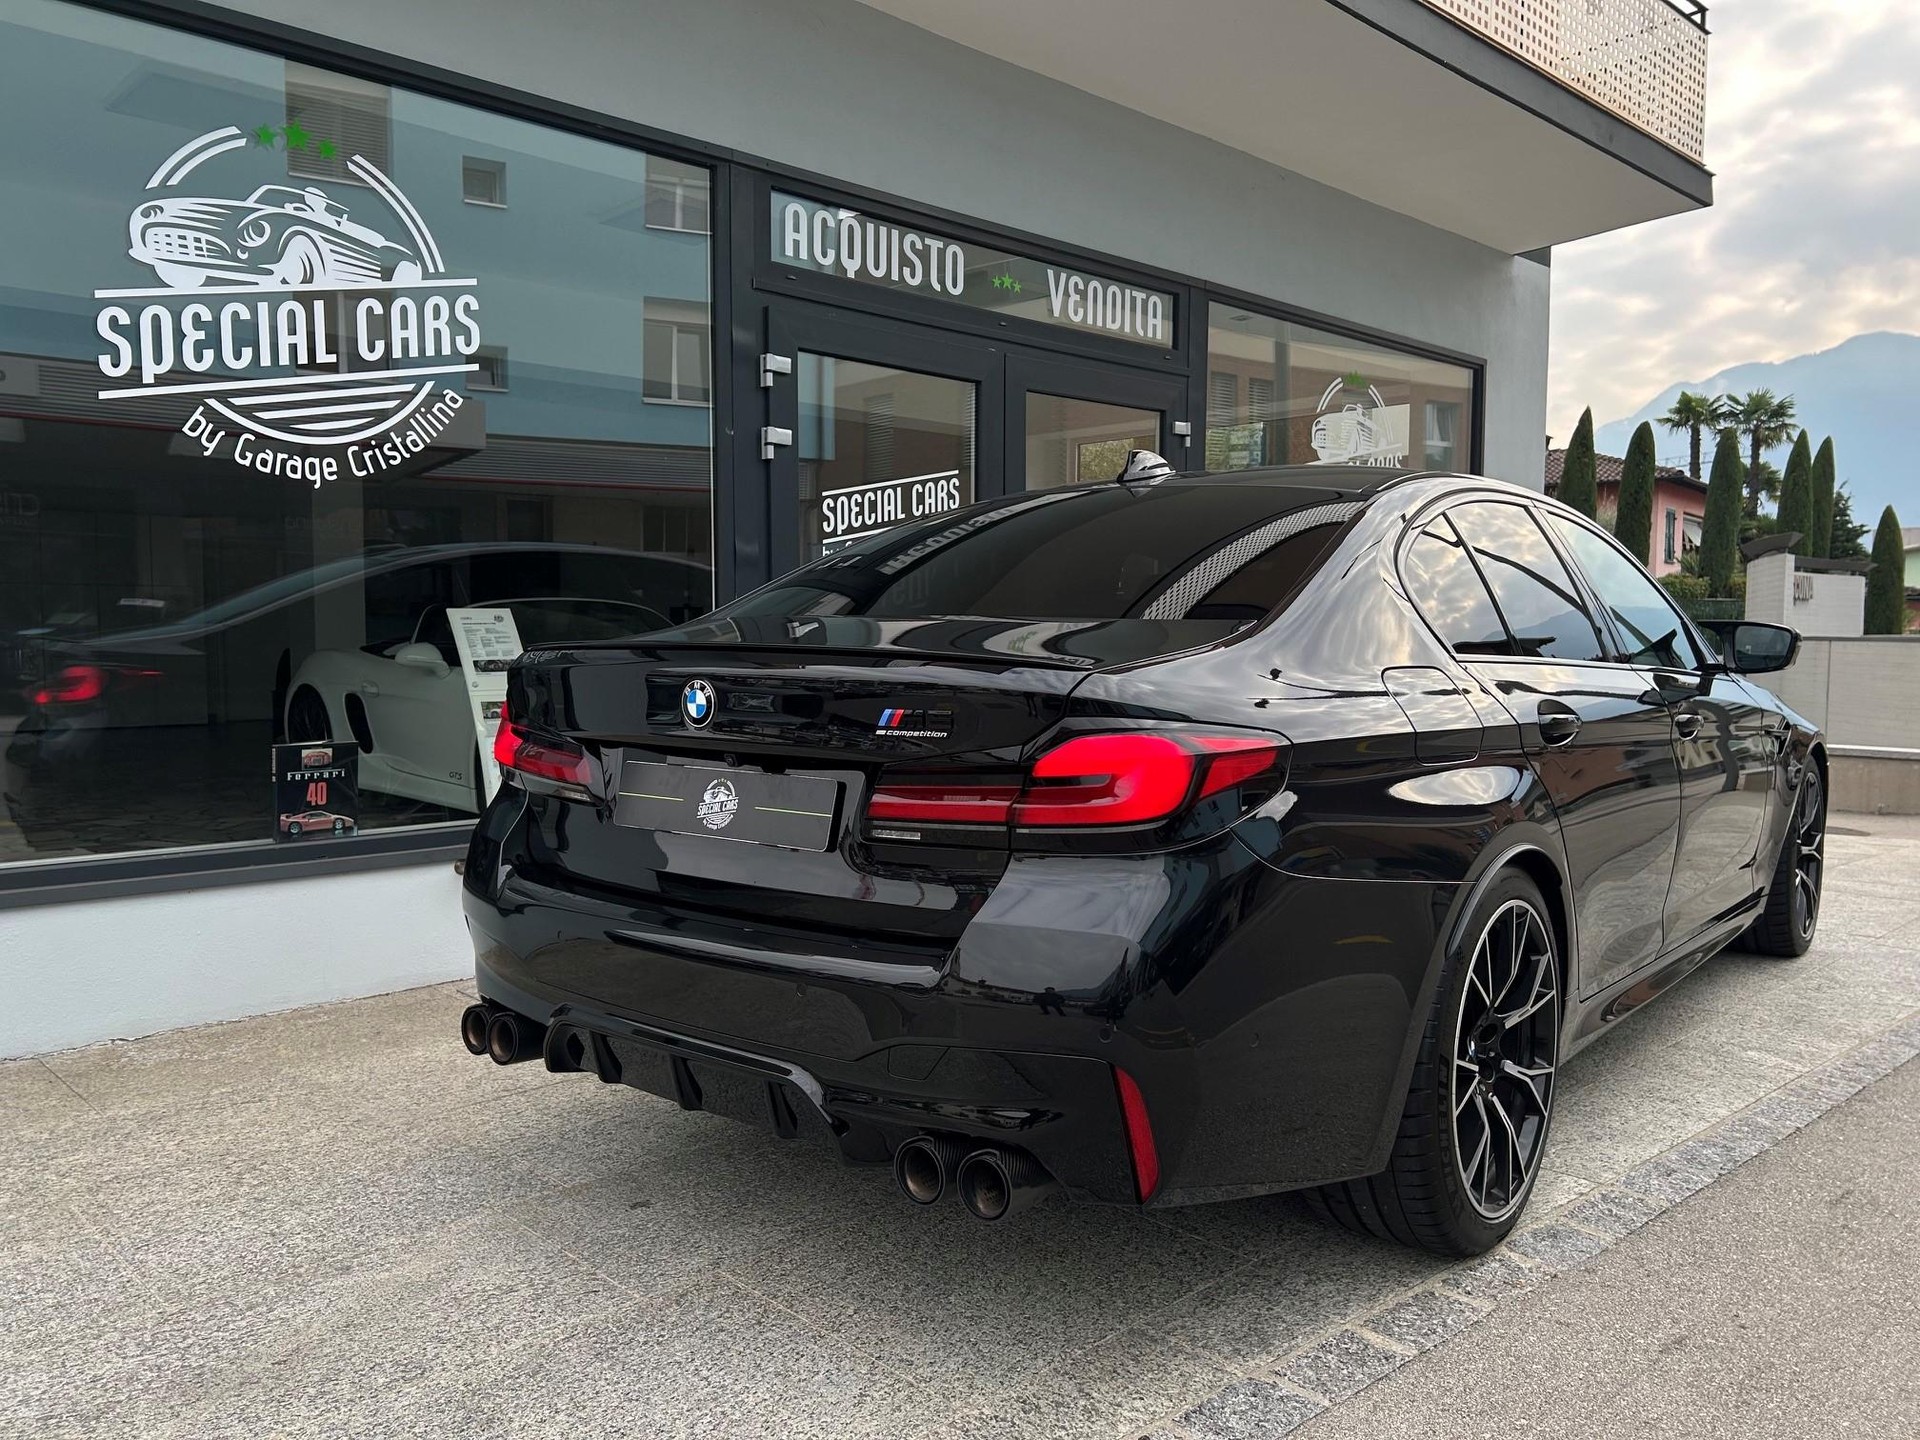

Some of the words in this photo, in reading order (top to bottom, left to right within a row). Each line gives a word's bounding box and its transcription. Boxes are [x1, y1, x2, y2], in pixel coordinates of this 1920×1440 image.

[784, 202, 965, 296] ACQUISTO
[1047, 268, 1163, 340] VENDITA
[96, 300, 337, 384] SPECIAL
[357, 294, 481, 362] CARS
[182, 405, 226, 458] by
[233, 433, 339, 489] Garage
[347, 388, 464, 478] Cristallina
[822, 486, 906, 535] SPECIAL
[911, 478, 960, 517] CARS
[886, 729, 948, 739] competition
[287, 768, 345, 781] Ferrari
[306, 781, 327, 806] 40
